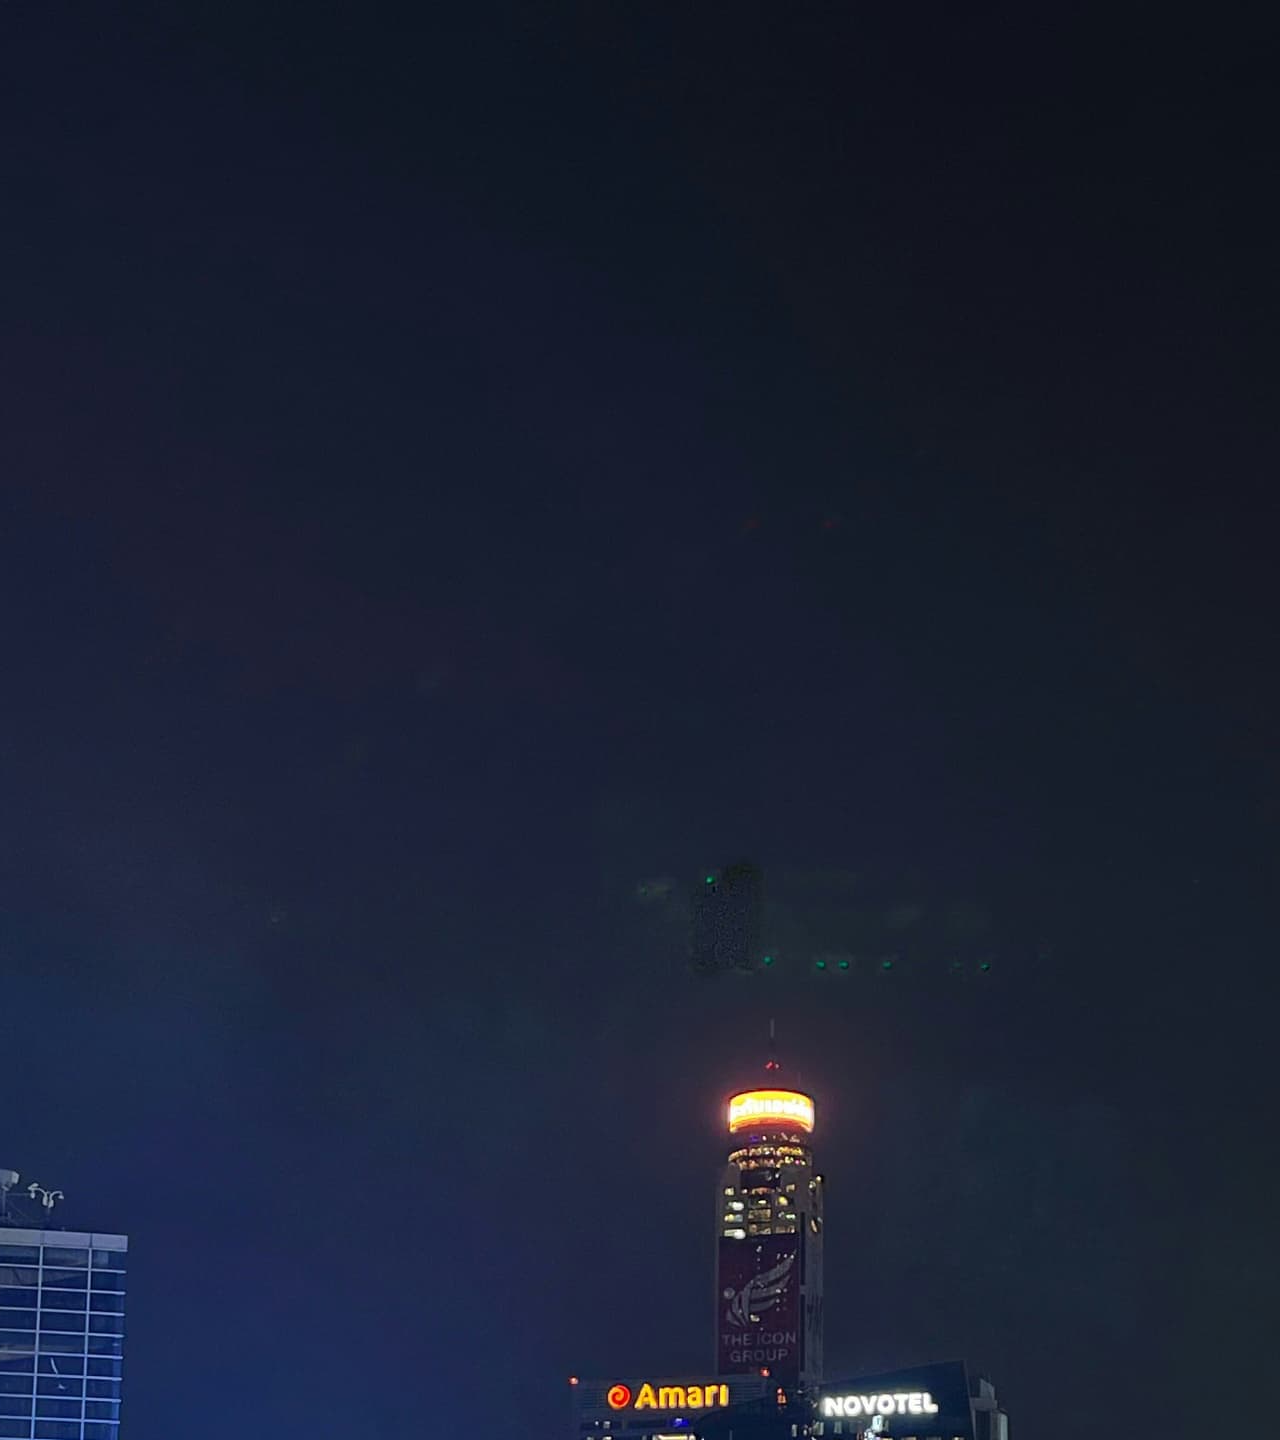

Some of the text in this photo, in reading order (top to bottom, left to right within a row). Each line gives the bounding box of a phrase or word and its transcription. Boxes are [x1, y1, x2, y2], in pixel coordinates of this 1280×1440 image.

[722, 1331, 797, 1346] THE ICON
[730, 1348, 789, 1362] GROUP
[634, 1382, 729, 1410] Amari
[823, 1392, 939, 1417] NOVOTEL
